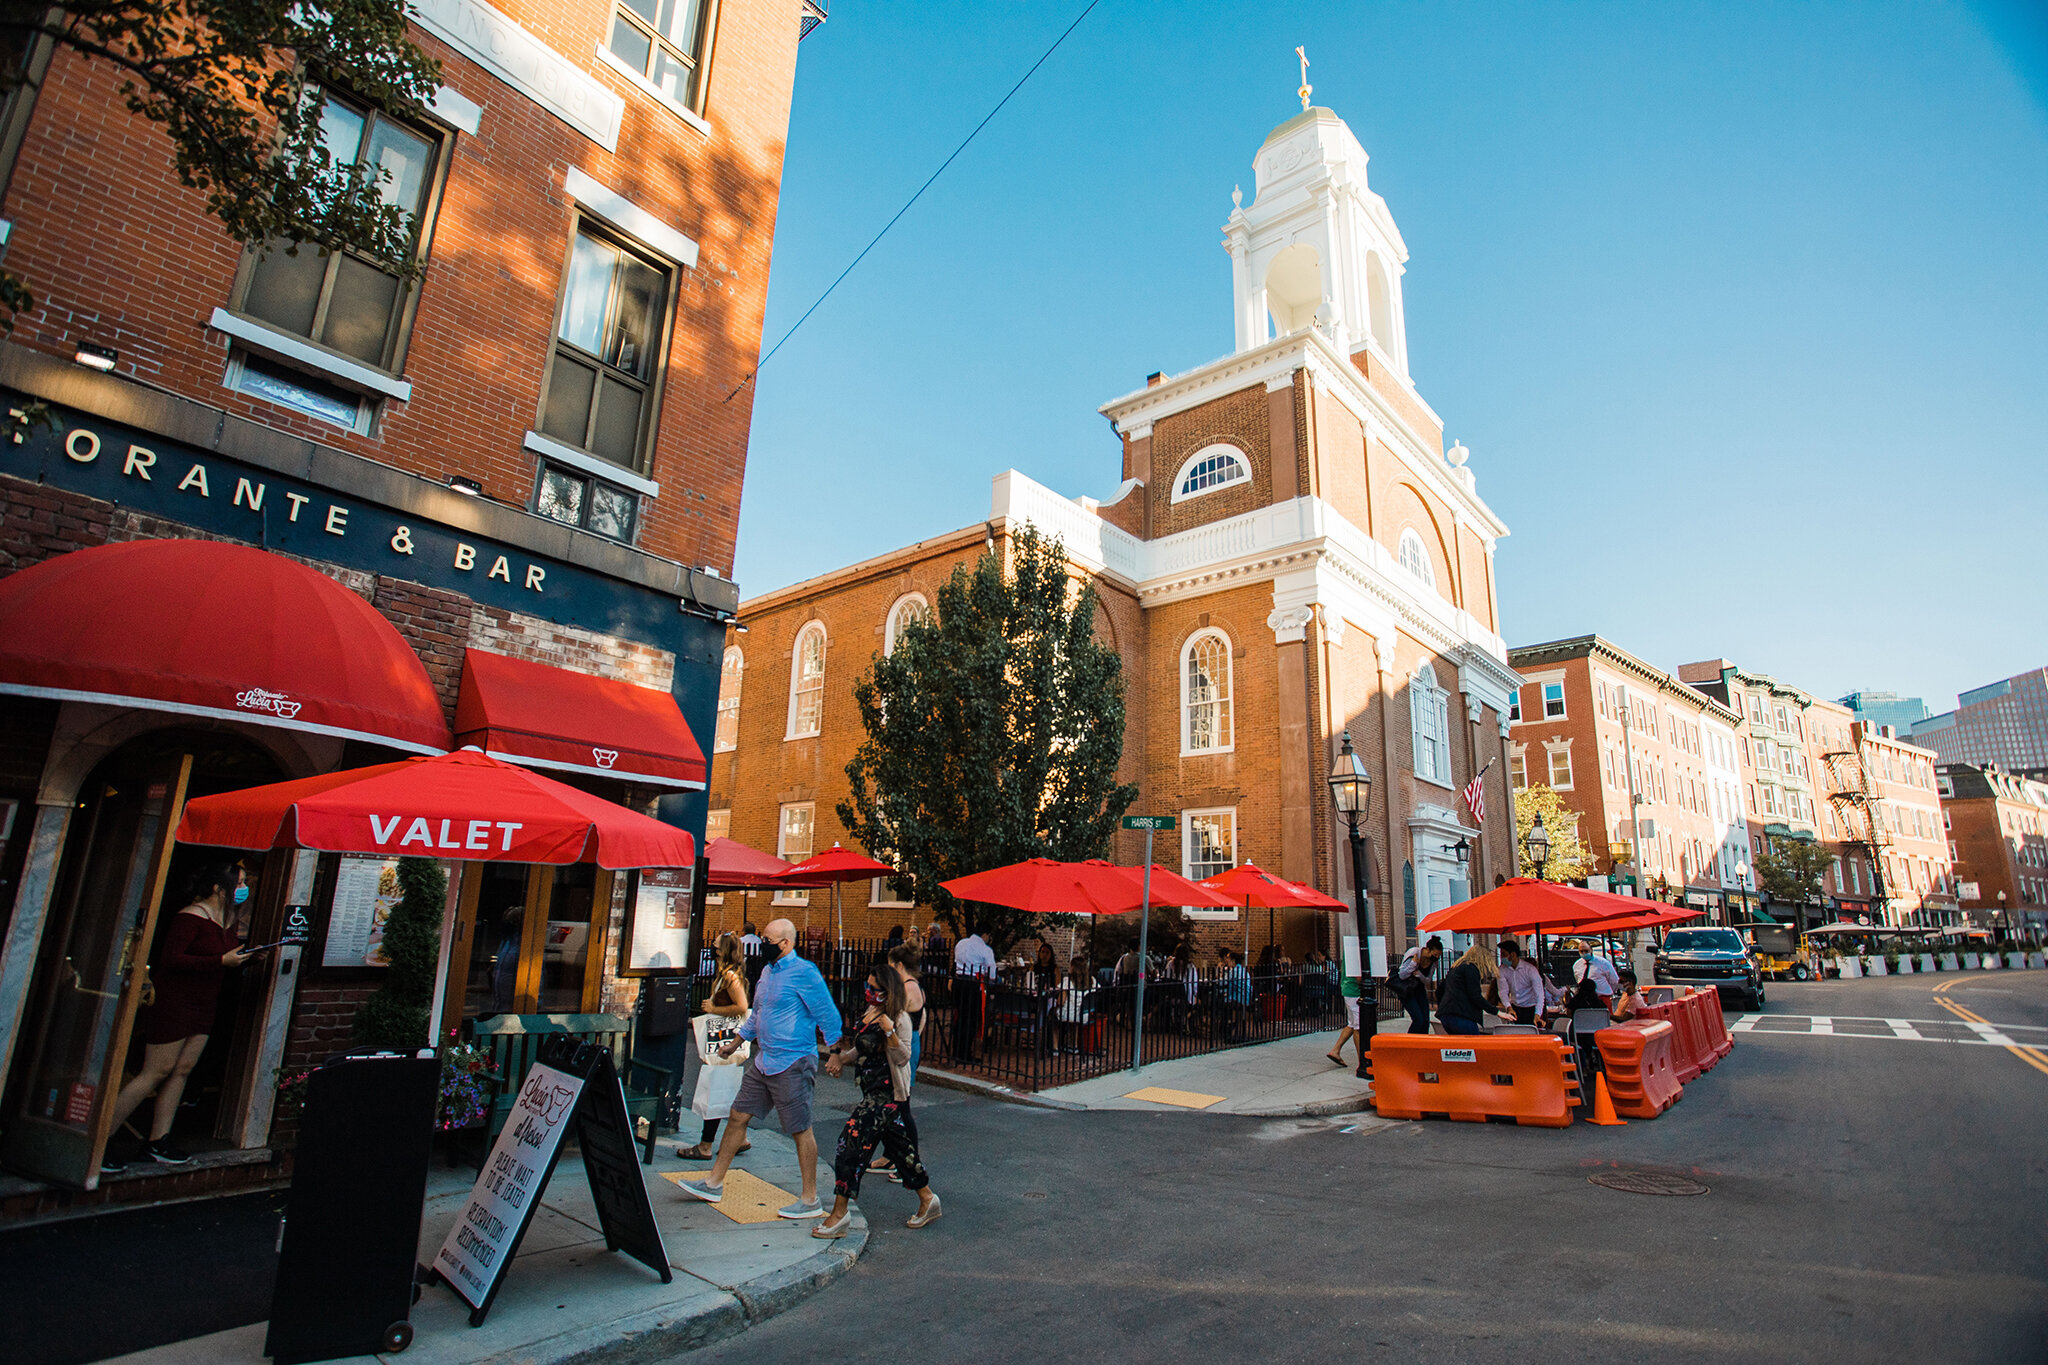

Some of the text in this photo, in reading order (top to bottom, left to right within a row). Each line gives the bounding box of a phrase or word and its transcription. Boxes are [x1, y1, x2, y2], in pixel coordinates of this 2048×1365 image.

[391, 525, 415, 556] &
[453, 543, 547, 593] BAR
[236, 690, 275, 711] Lucia
[368, 813, 523, 852] VALET
[1131, 818, 1162, 828] HARRIS ST
[519, 1074, 552, 1117] Lucia
[483, 1169, 526, 1209] TO BE SEATED
[493, 1151, 535, 1188] PLEASE WAIT
[465, 1201, 508, 1244] RESERVATIONS
[455, 1224, 497, 1269] RECOMMENDED
